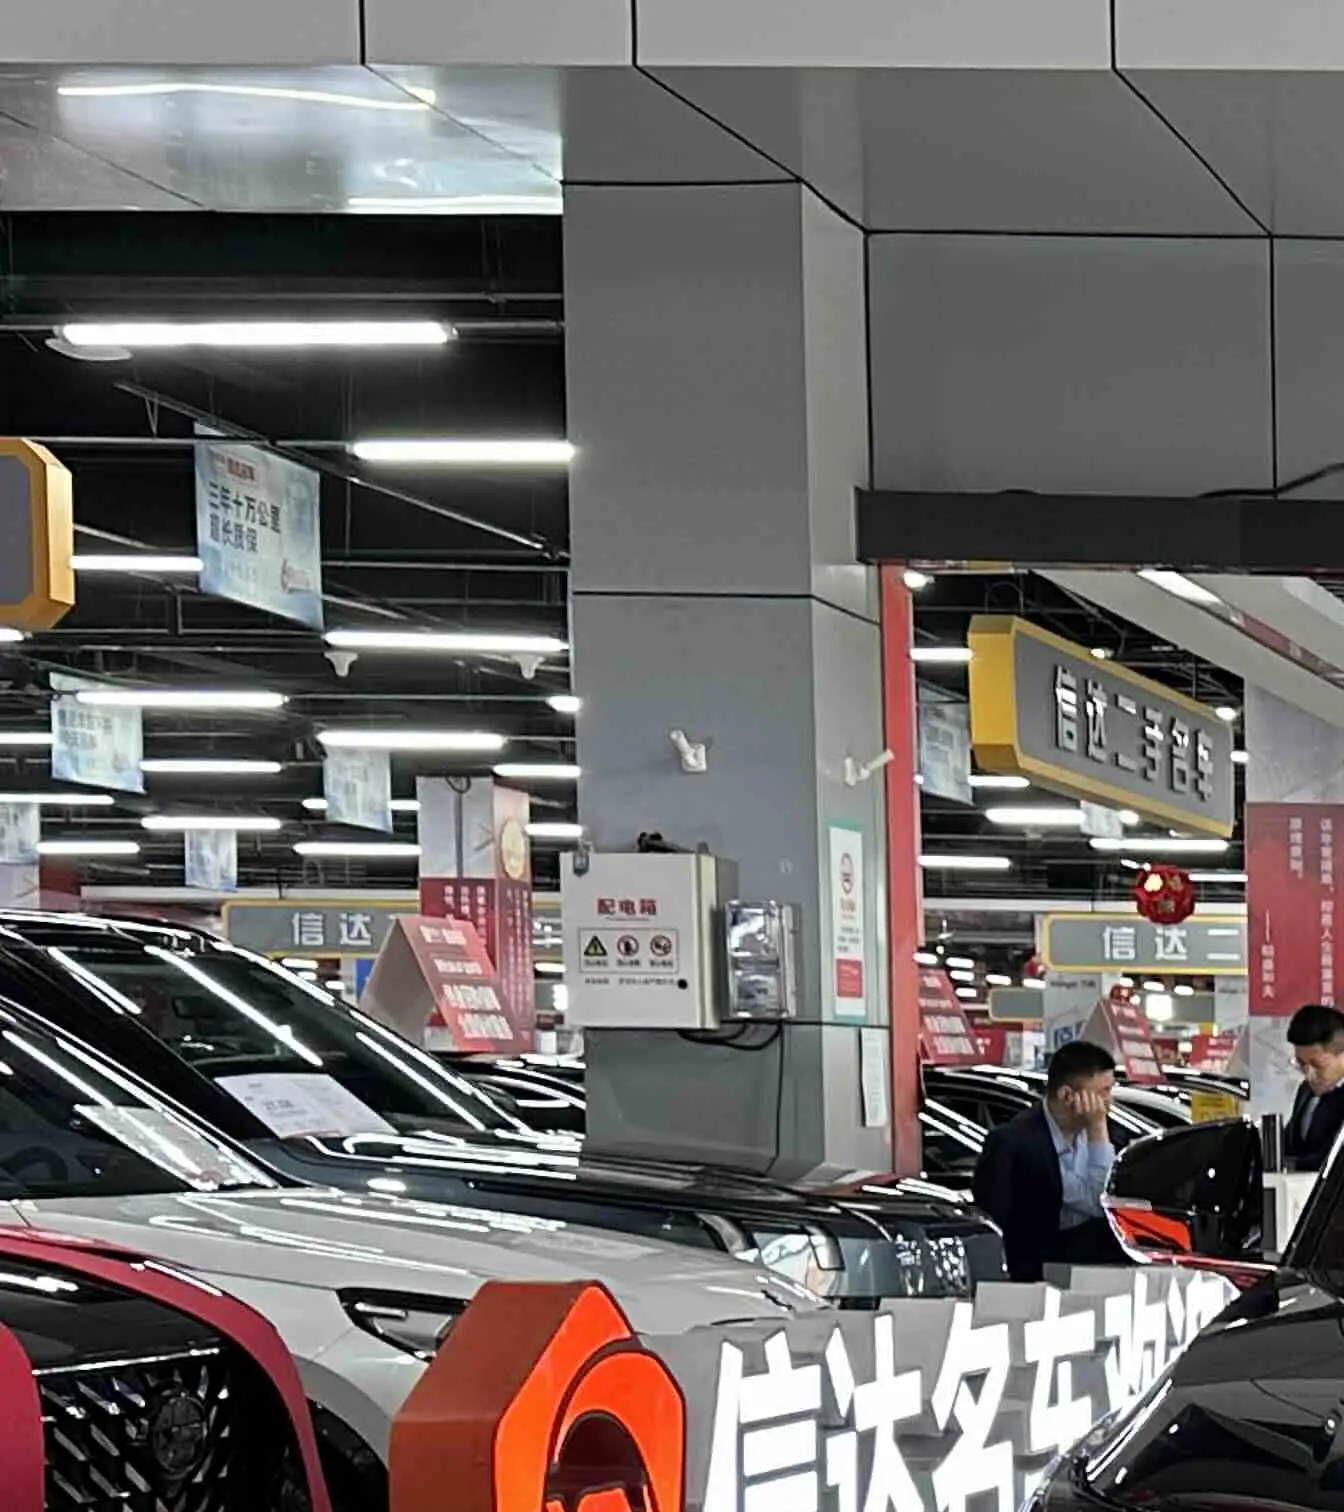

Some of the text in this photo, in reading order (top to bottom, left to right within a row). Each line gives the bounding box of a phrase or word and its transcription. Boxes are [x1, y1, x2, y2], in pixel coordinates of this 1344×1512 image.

[1054, 664, 1214, 801] 信达二手名车
[596, 898, 657, 915] 配电箱
